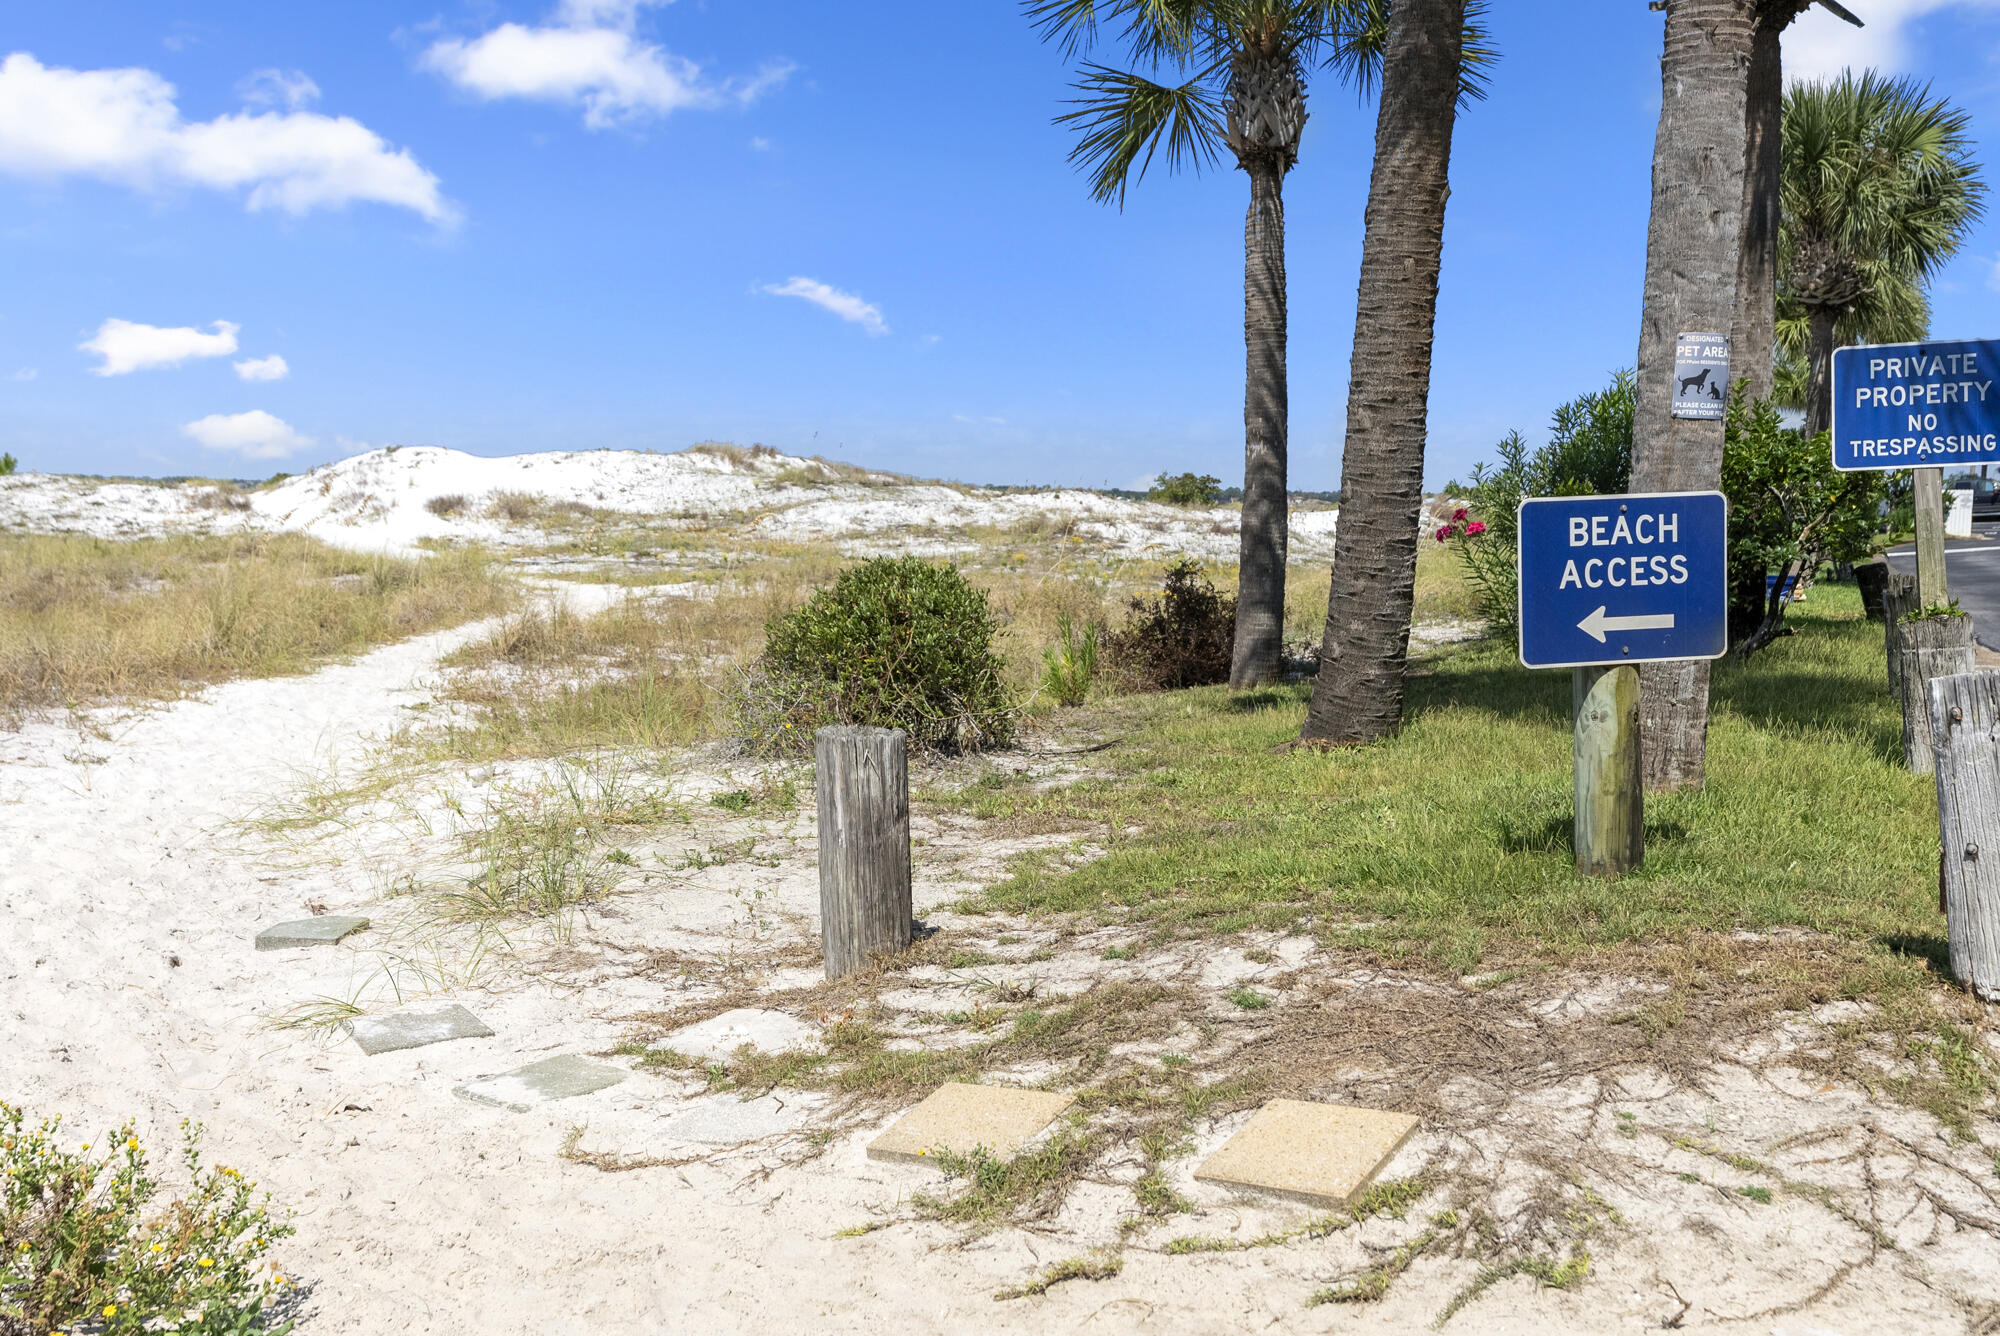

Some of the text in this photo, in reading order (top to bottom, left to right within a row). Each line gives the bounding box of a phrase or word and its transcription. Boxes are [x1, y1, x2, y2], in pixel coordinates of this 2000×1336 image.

[1676, 345, 1728, 358] PET AREA
[1686, 335, 1724, 343] DESIGNATED
[1870, 353, 1978, 380] PRIVATE
[1675, 401, 1699, 409] PLEASE
[1856, 380, 1993, 409] PROPERTY
[1908, 413, 1938, 432] NO
[1850, 433, 1997, 458] TRESPASSING
[1569, 513, 1678, 547] BEACH
[1559, 554, 1689, 590] ACCESS
